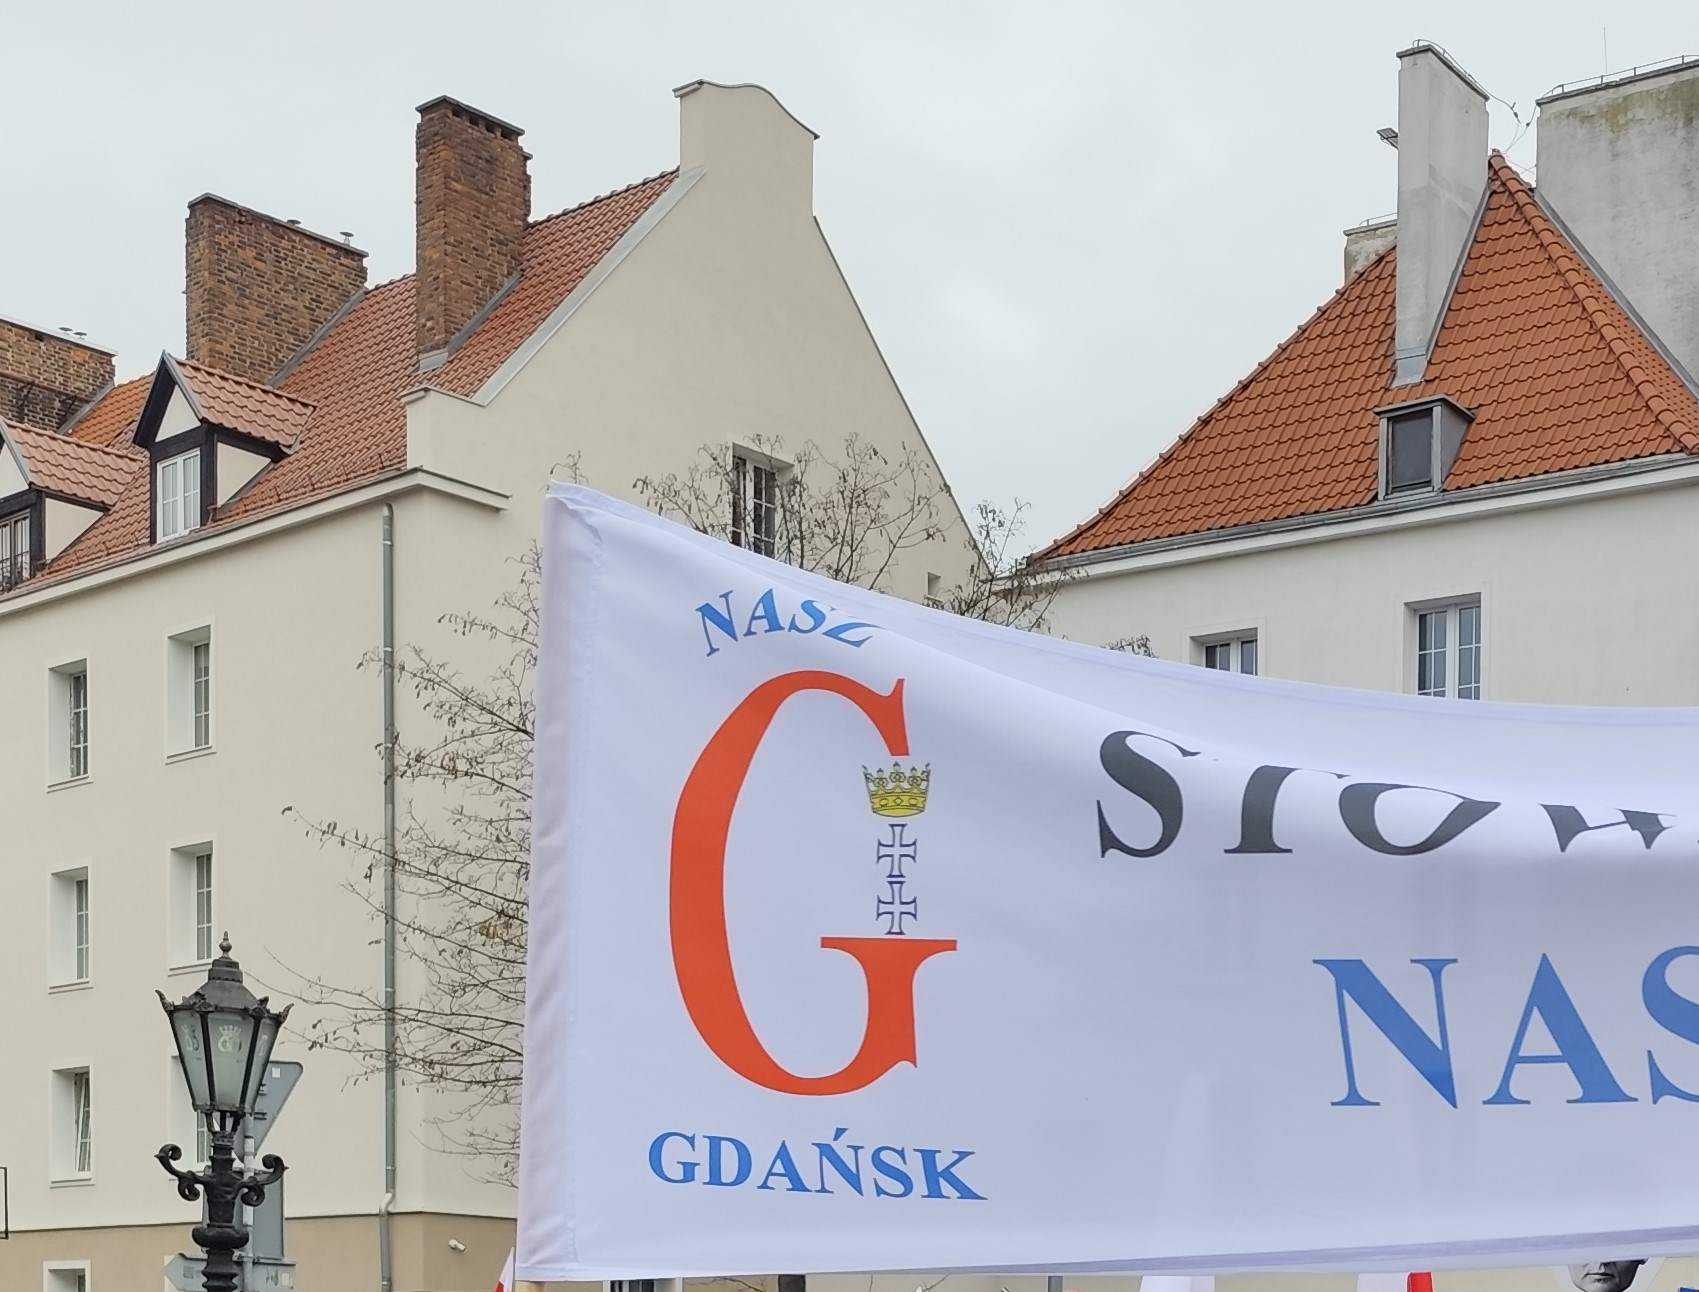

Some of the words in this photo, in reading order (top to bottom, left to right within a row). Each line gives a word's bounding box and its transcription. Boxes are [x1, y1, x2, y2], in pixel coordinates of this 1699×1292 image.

[695, 588, 886, 657] NASZ
[669, 670, 957, 1095] G
[648, 1127, 988, 1201] GDAŃSK
